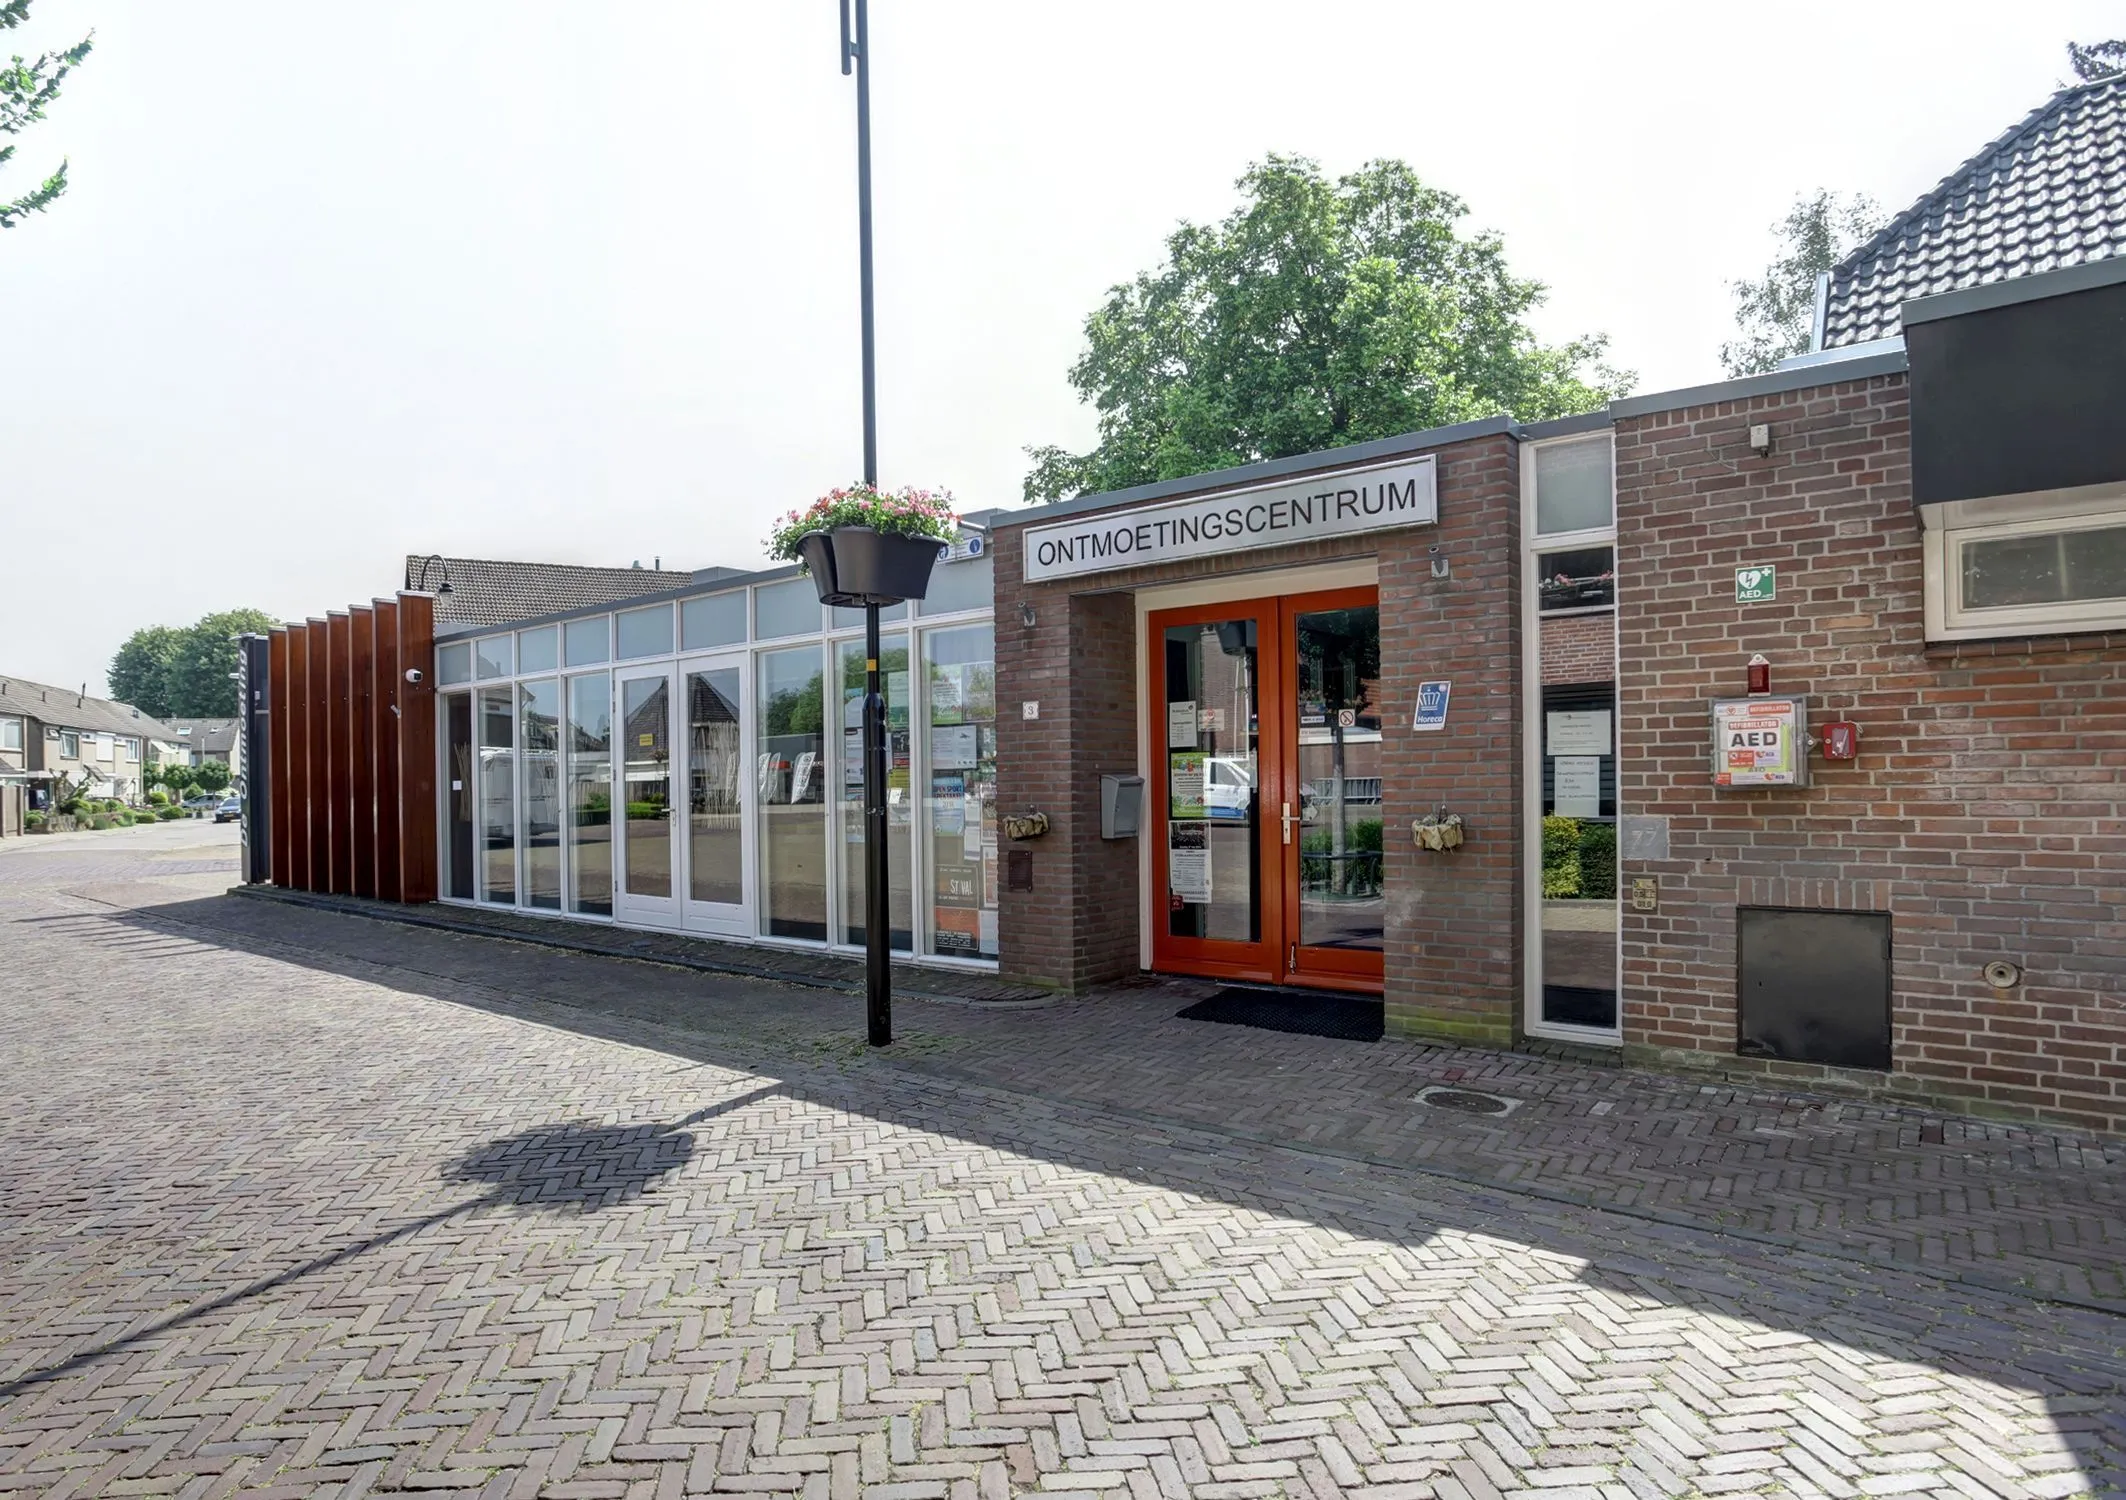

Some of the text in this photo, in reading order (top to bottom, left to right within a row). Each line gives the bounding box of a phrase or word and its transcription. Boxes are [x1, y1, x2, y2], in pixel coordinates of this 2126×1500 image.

[1037, 478, 1417, 567] ONTMOETINGSCENTRUM
[1738, 589, 1762, 600] AED
[1417, 715, 1443, 723] Horeca
[1731, 732, 1778, 748] AED
[238, 649, 249, 848] De Ontmoeting
